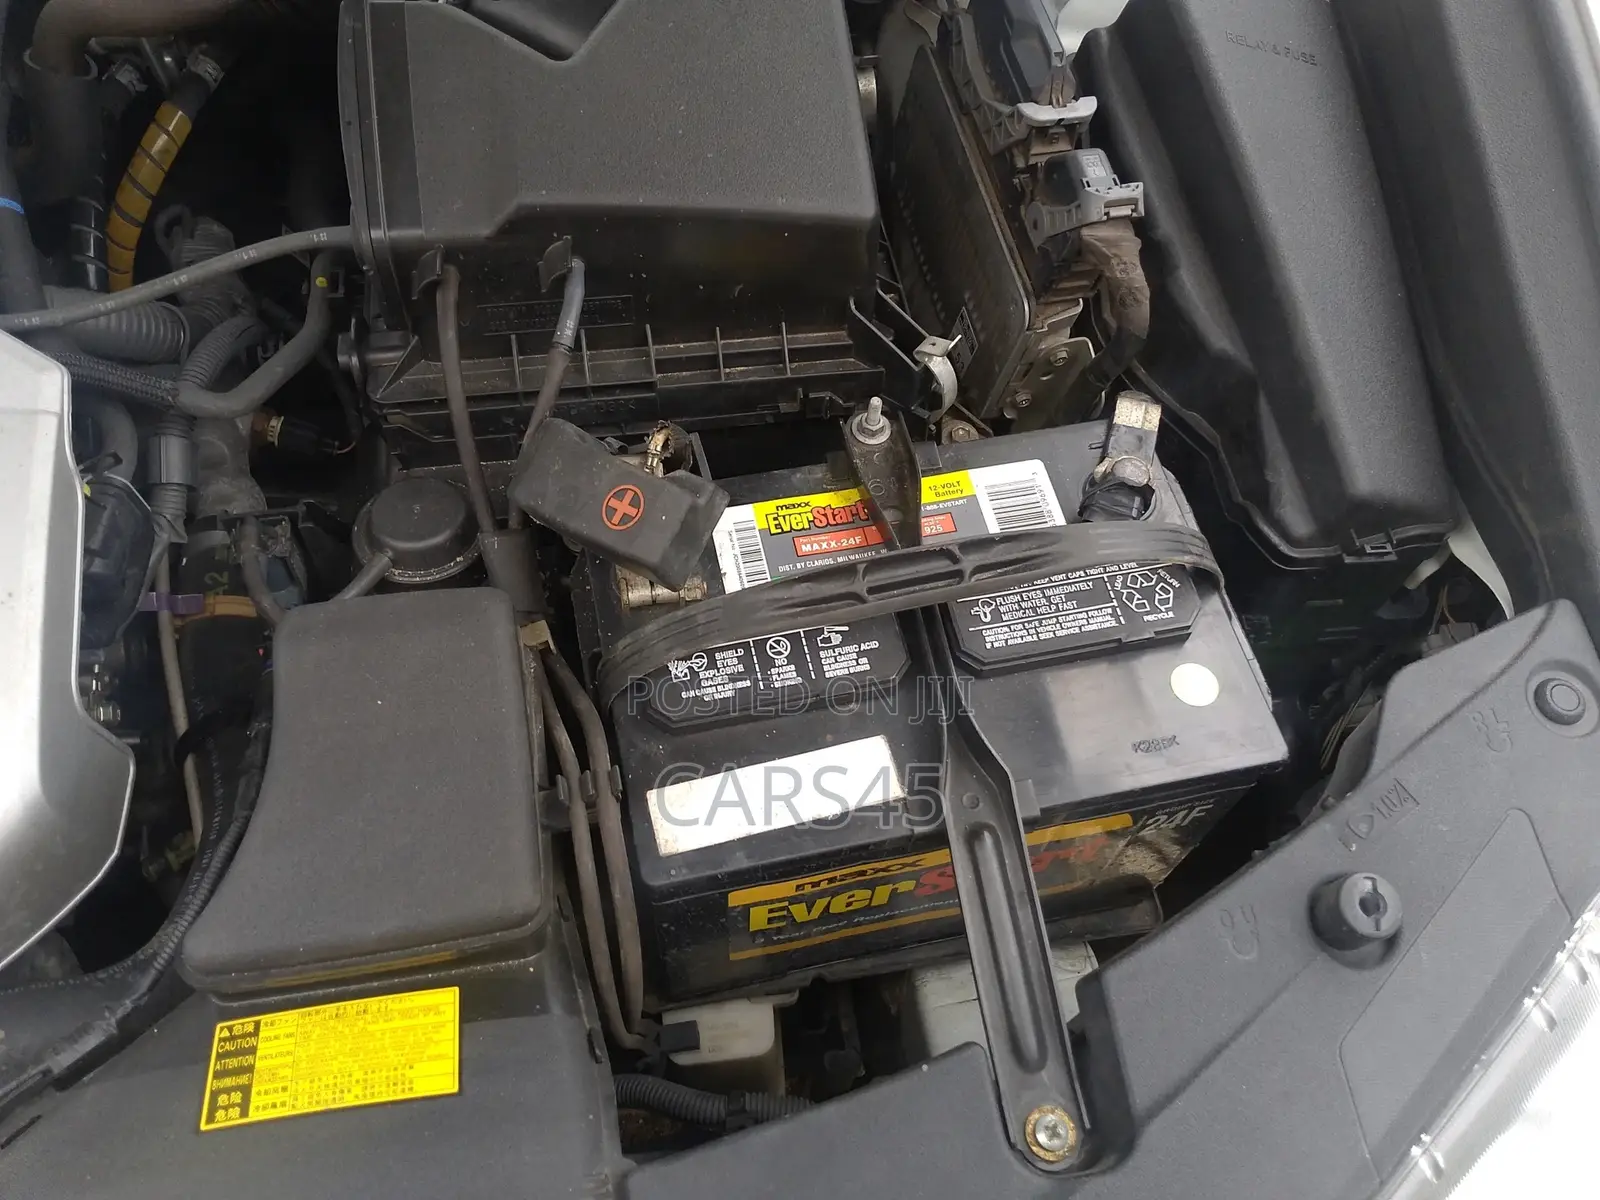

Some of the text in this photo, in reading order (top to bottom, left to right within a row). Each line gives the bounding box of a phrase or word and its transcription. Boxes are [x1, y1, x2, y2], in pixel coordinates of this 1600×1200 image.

[928, 480, 962, 493] 12-VOLT
[935, 488, 964, 498] Battery
[776, 500, 812, 512] maxx
[766, 500, 871, 536] EverStart
[924, 524, 944, 534] 925
[801, 536, 863, 553] MAXX-24F
[796, 561, 806, 570] BY
[1050, 574, 1067, 582] VENT
[1068, 570, 1085, 579] CAPS
[1105, 565, 1119, 573] AND
[1119, 562, 1139, 571] LEVEL
[1114, 575, 1123, 591] LEAD
[1156, 568, 1181, 589] RETURN
[995, 594, 1021, 606] FLUSH
[1022, 590, 1043, 601] EYES
[1044, 581, 1094, 597] IMMEDIATELY
[998, 603, 1019, 613] WITH
[1050, 594, 1067, 604] GET
[1000, 600, 1078, 622] MEDICAL HELP FAST
[1011, 623, 1024, 631] FOR
[1024, 620, 1040, 628] SAFE
[1041, 618, 1057, 626] JUMP
[1058, 612, 1088, 623] STARTING
[1088, 607, 1113, 618] FOLLOW
[1143, 611, 1176, 623] RECYCLE
[984, 630, 1029, 643] INSTRUCTIONS
[1036, 624, 1061, 634] VEHICLE
[993, 640, 1006, 648] NOT
[1007, 634, 1039, 646] AVAILABLE
[1038, 631, 1056, 641] SEEK
[1055, 626, 1081, 638] SERVICE
[715, 648, 745, 660] SHIELD
[819, 640, 880, 659] SULFURIC ACID
[716, 657, 739, 668] EYES
[774, 658, 788, 667] NO
[821, 652, 858, 665] CAN CAUSE
[858, 657, 869, 665] OR
[699, 664, 745, 679] EXPLOSIVE
[825, 668, 849, 678] SEVERE
[701, 675, 730, 687] GASES
[681, 689, 696, 698] CAN
[695, 686, 717, 697] CAUSE
[1137, 804, 1214, 836] 24F
[795, 858, 926, 893] maxx
[217, 1036, 258, 1053] CAUTION
[215, 1055, 256, 1071] ATTENTION
[212, 1073, 252, 1091] ВНИМАНИЕ!
